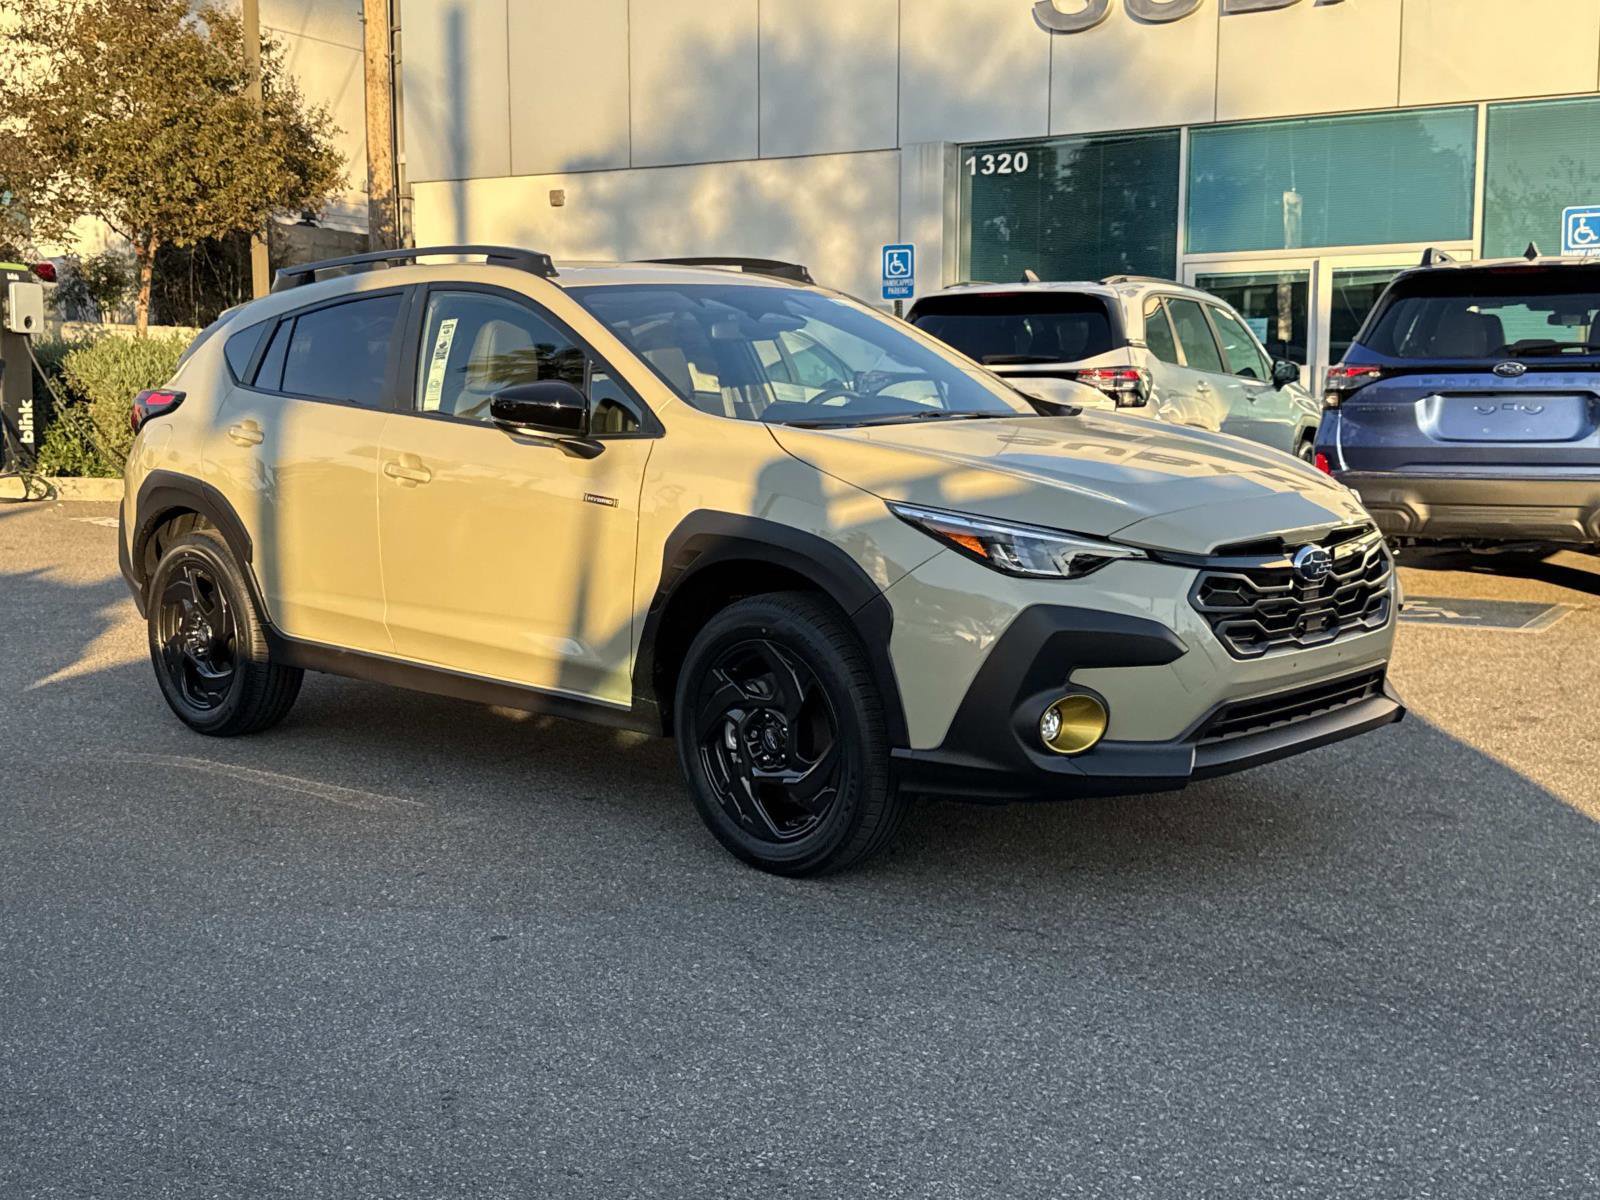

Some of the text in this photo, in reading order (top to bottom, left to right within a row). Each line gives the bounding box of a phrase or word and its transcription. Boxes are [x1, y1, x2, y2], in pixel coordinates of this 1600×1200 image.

[965, 151, 1029, 176] 1320
[18, 399, 34, 443] blink
[587, 495, 614, 505] HYBRID
